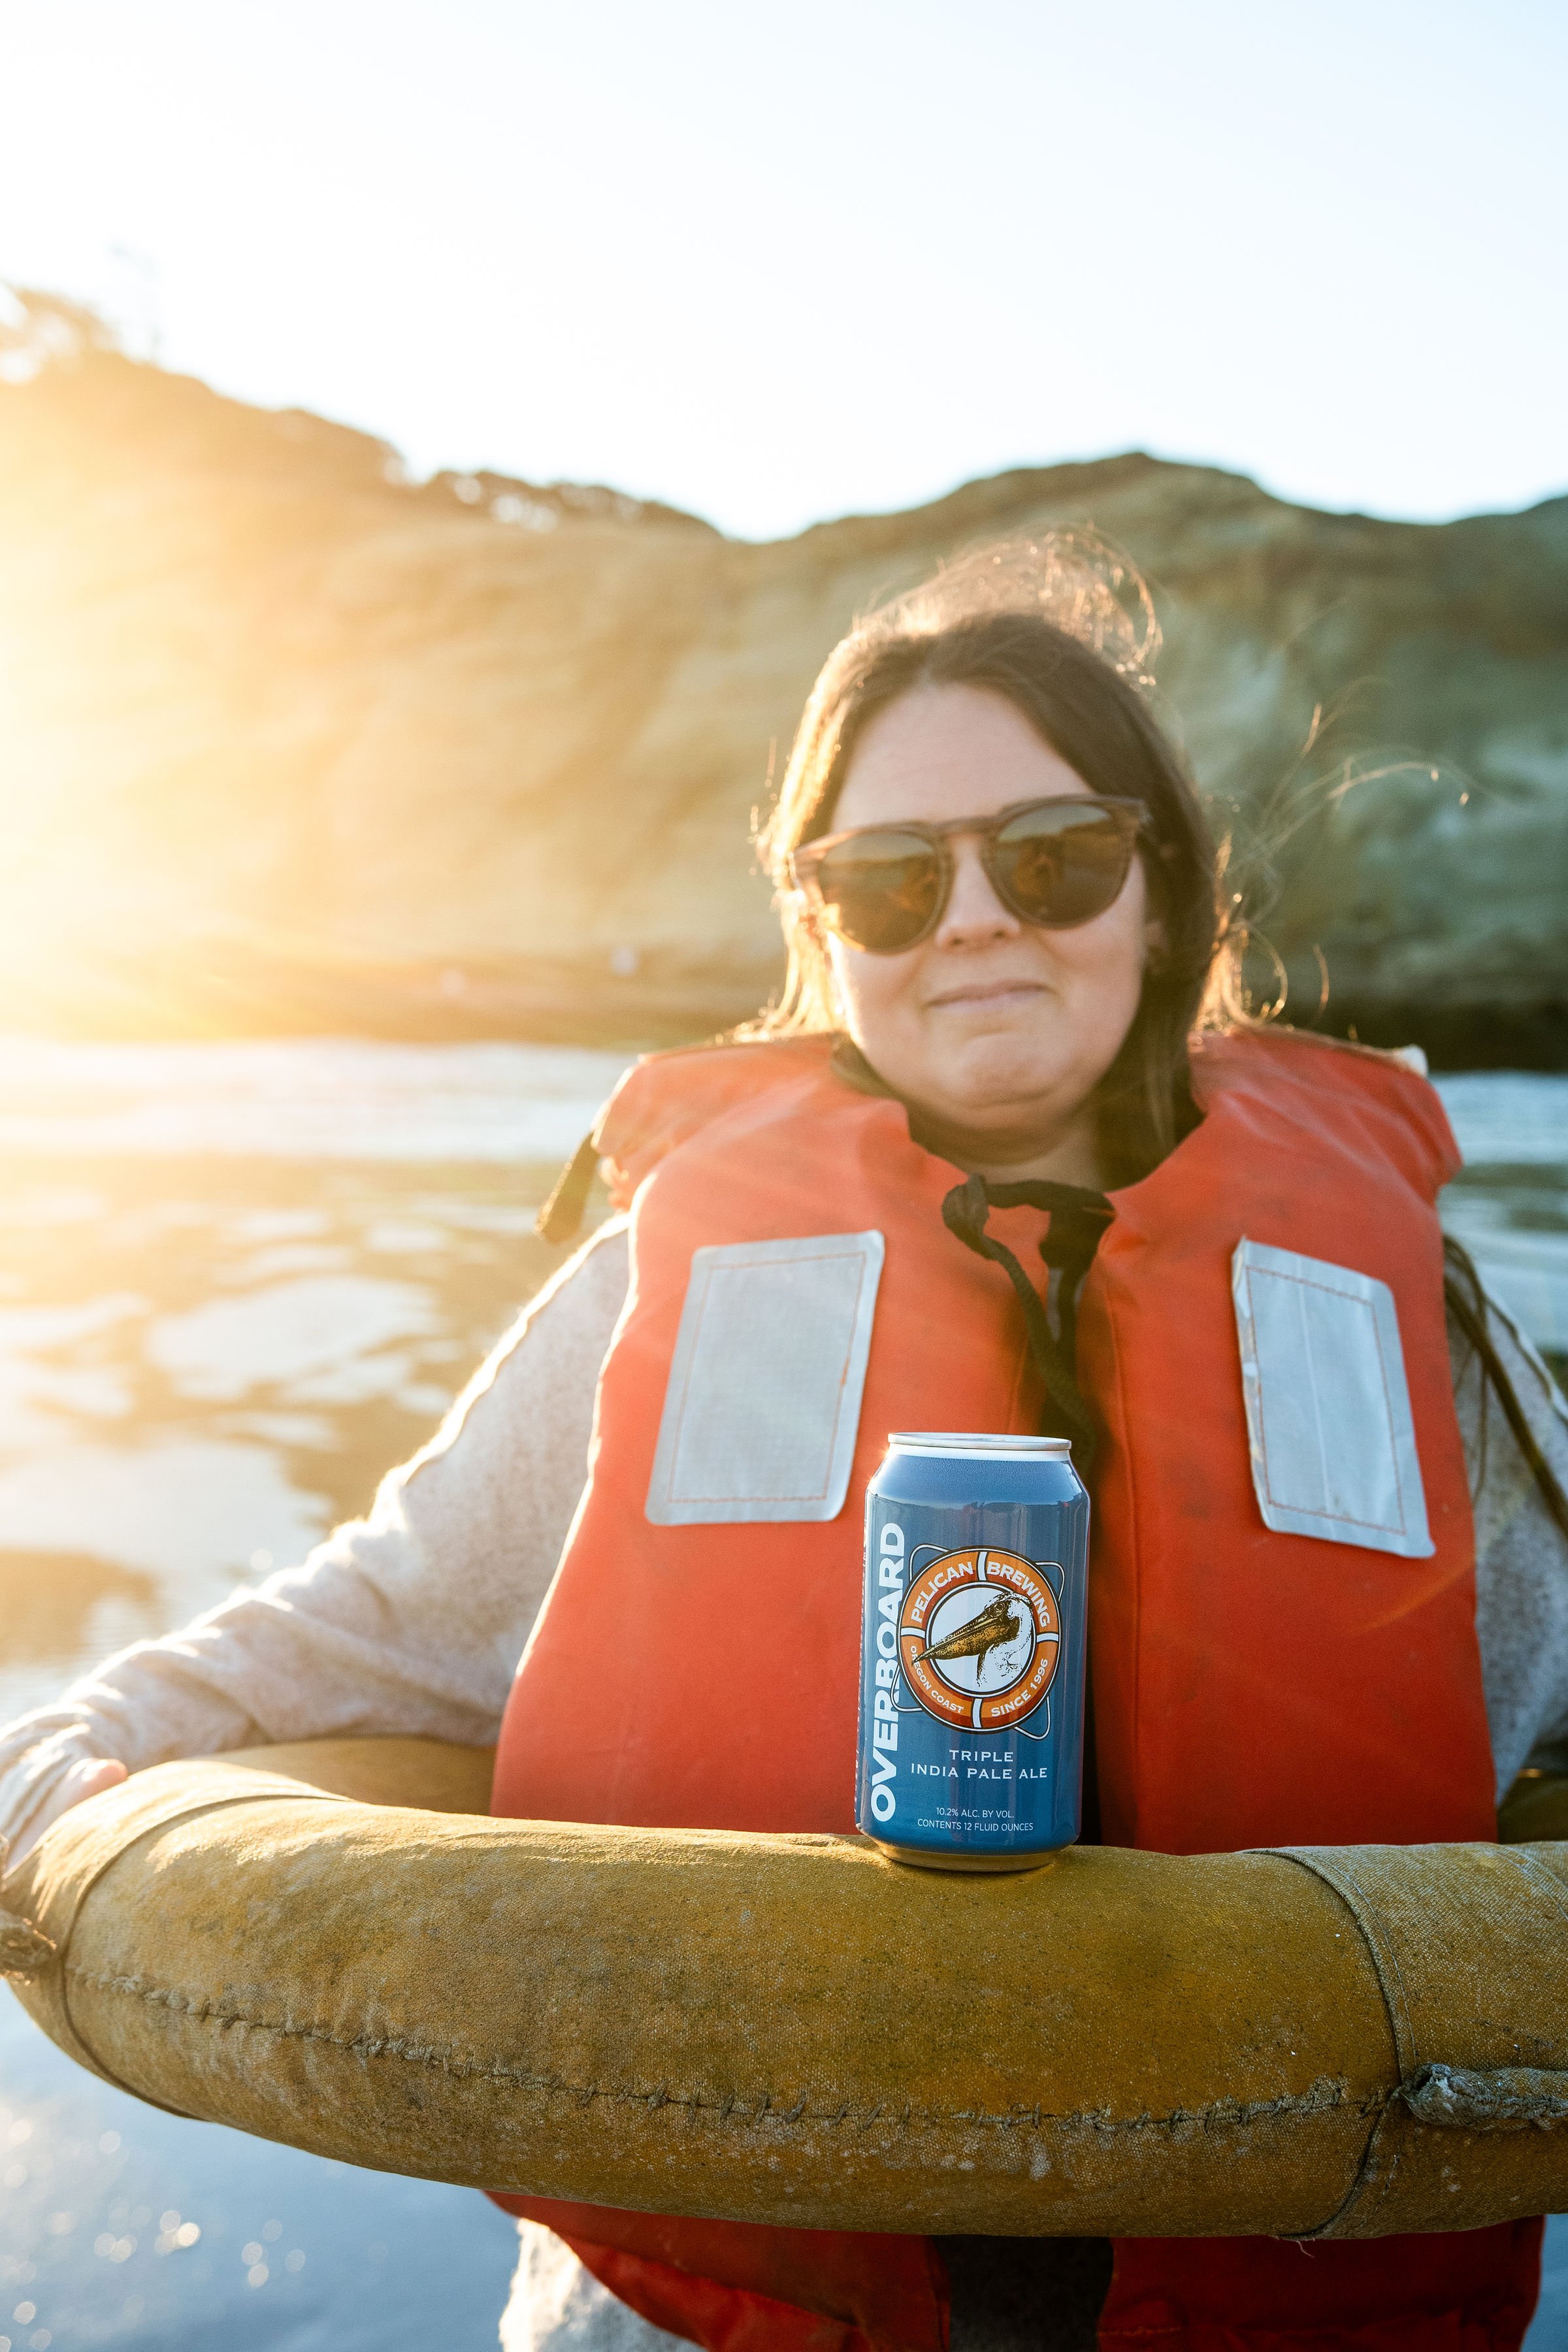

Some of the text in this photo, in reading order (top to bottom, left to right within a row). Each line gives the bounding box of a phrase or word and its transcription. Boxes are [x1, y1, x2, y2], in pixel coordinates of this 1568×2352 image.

[911, 1561, 1051, 1627] PELICAN BREWING
[870, 1523, 905, 1822] OVERBOARD
[990, 1658, 1049, 1718] SINCE 1996
[930, 1690, 964, 1714] COAST
[949, 1750, 1013, 1762] TRIPLE
[911, 1763, 1047, 1780] INDIA PALE ALE
[936, 1807, 958, 1817] 10.2%
[960, 1809, 980, 1818] ALC.
[917, 1818, 962, 1830] CONTENTS
[974, 1823, 999, 1832] FLUID
[1001, 1823, 1034, 1831] OUNCES
